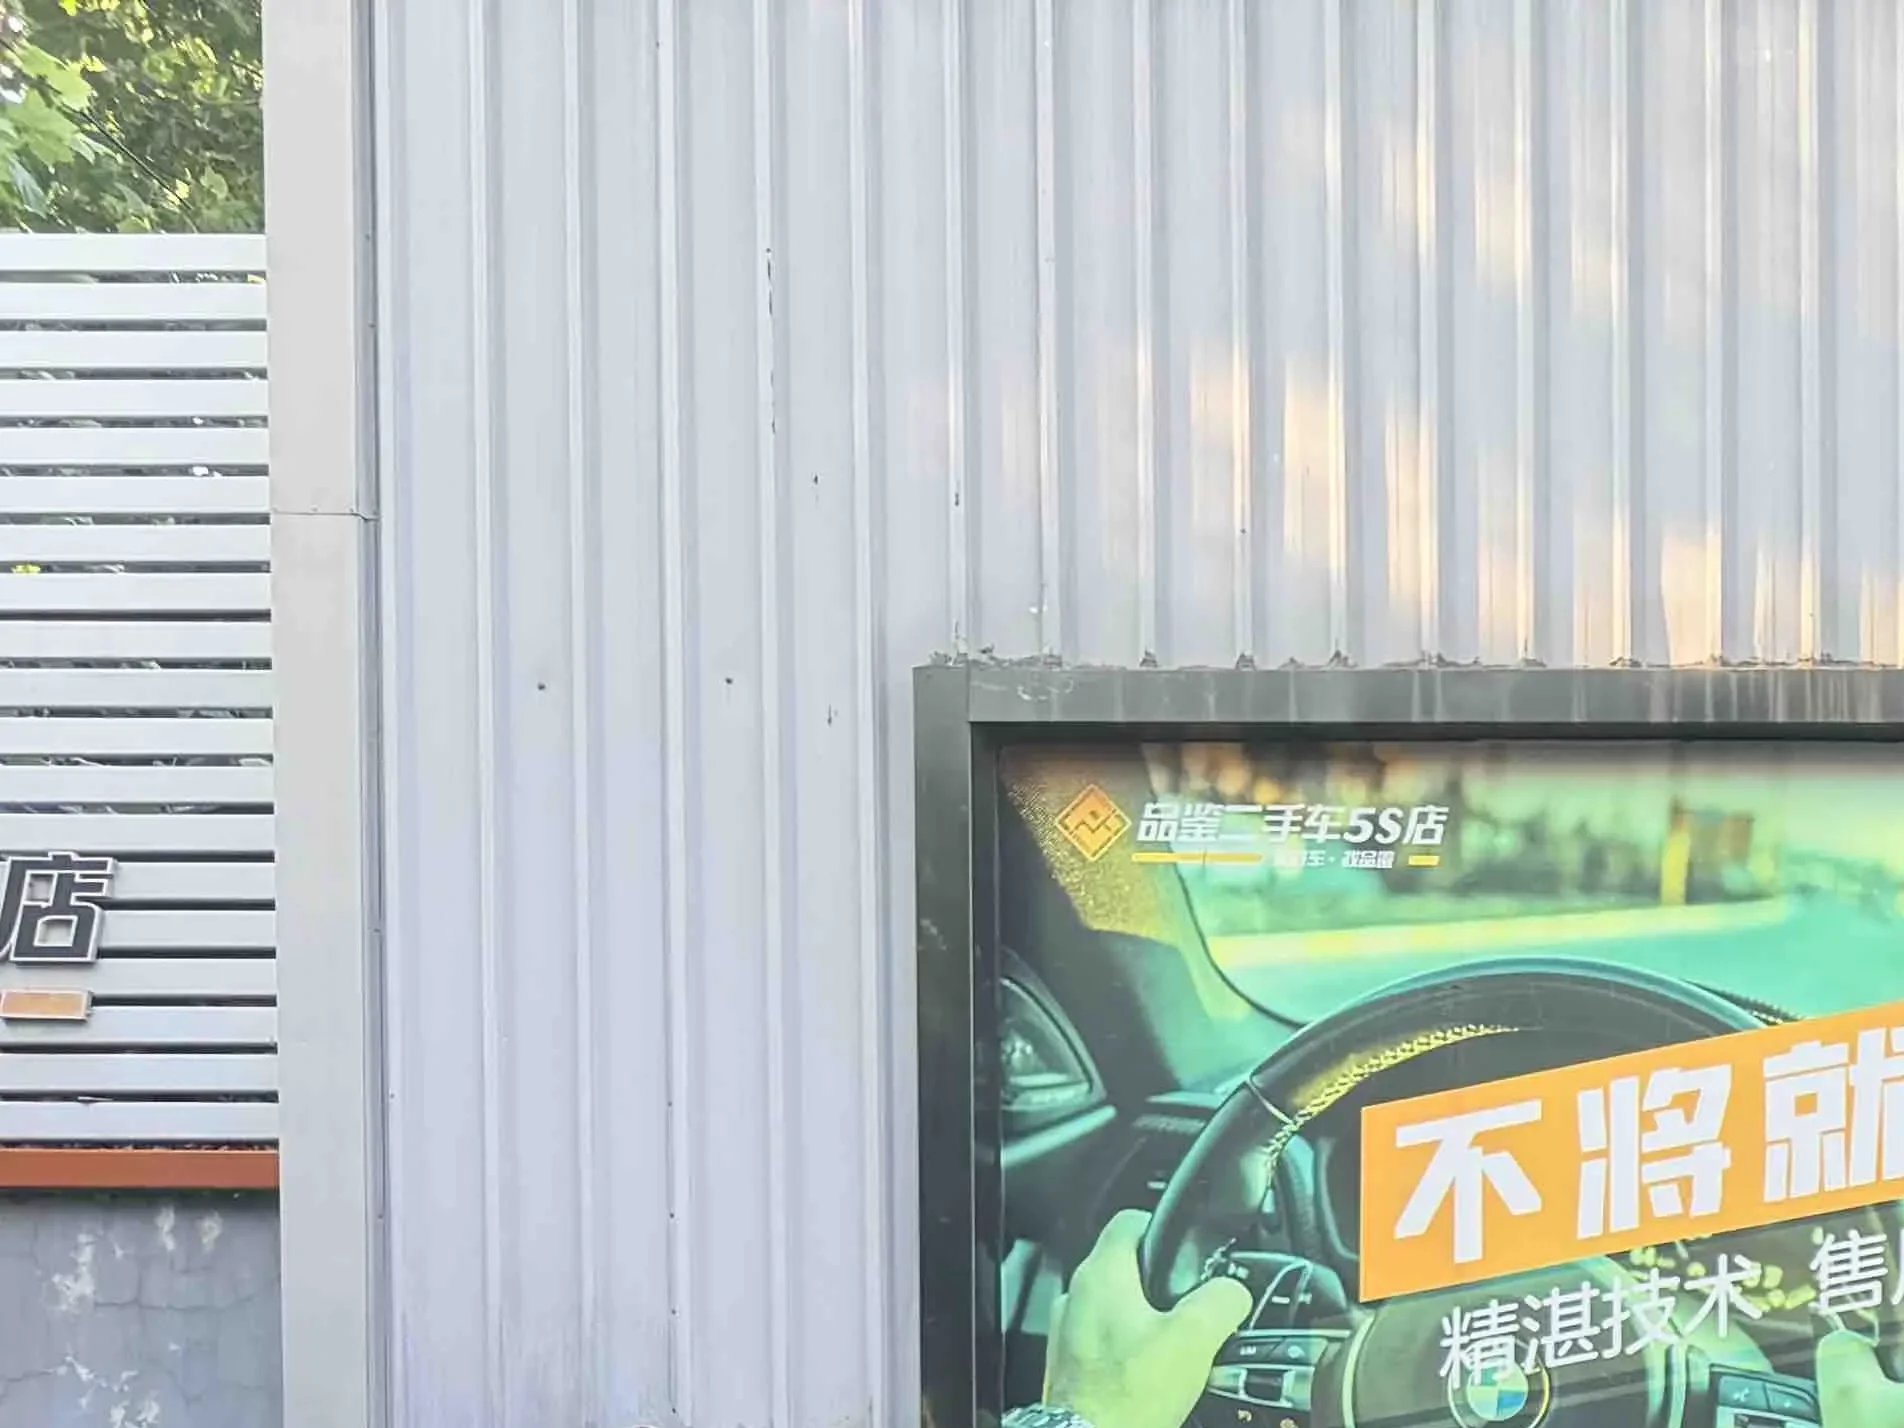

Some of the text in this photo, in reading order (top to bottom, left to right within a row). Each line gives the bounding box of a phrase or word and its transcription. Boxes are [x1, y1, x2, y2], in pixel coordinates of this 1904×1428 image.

[1137, 802, 1449, 846] 品鉴二手车5S店
[0, 852, 114, 963] 店
[1438, 1253, 1762, 1389] 精湛技术
